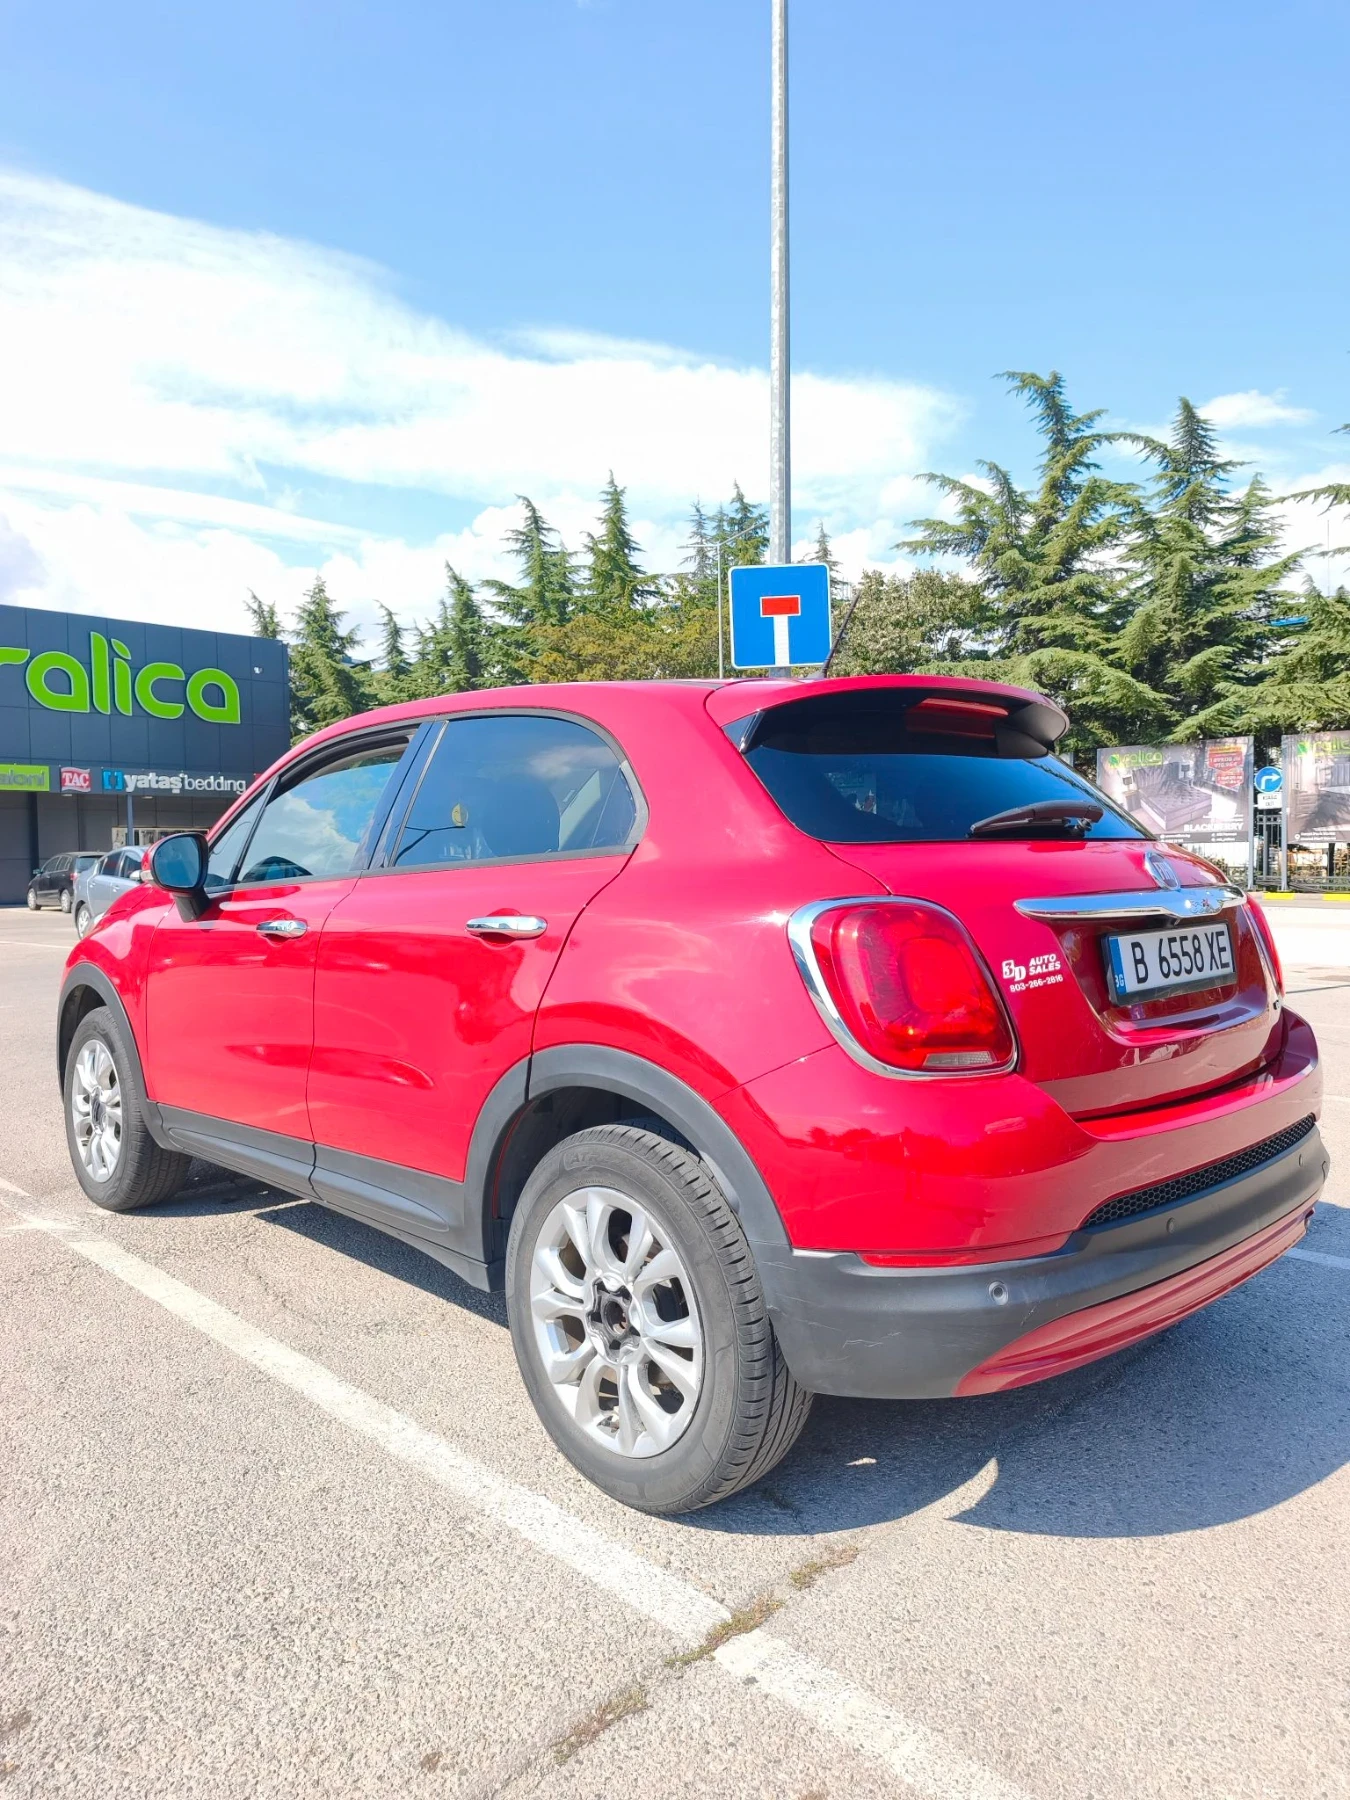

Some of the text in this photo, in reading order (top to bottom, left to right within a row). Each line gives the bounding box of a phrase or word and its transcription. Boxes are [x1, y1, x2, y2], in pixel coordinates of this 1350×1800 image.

[62, 772, 90, 788] TAÇ
[124, 772, 247, 795] yataş bedding
[1029, 953, 1057, 967] AUTO
[1130, 930, 1231, 984] B 6558 XE
[1029, 961, 1061, 976] SALES
